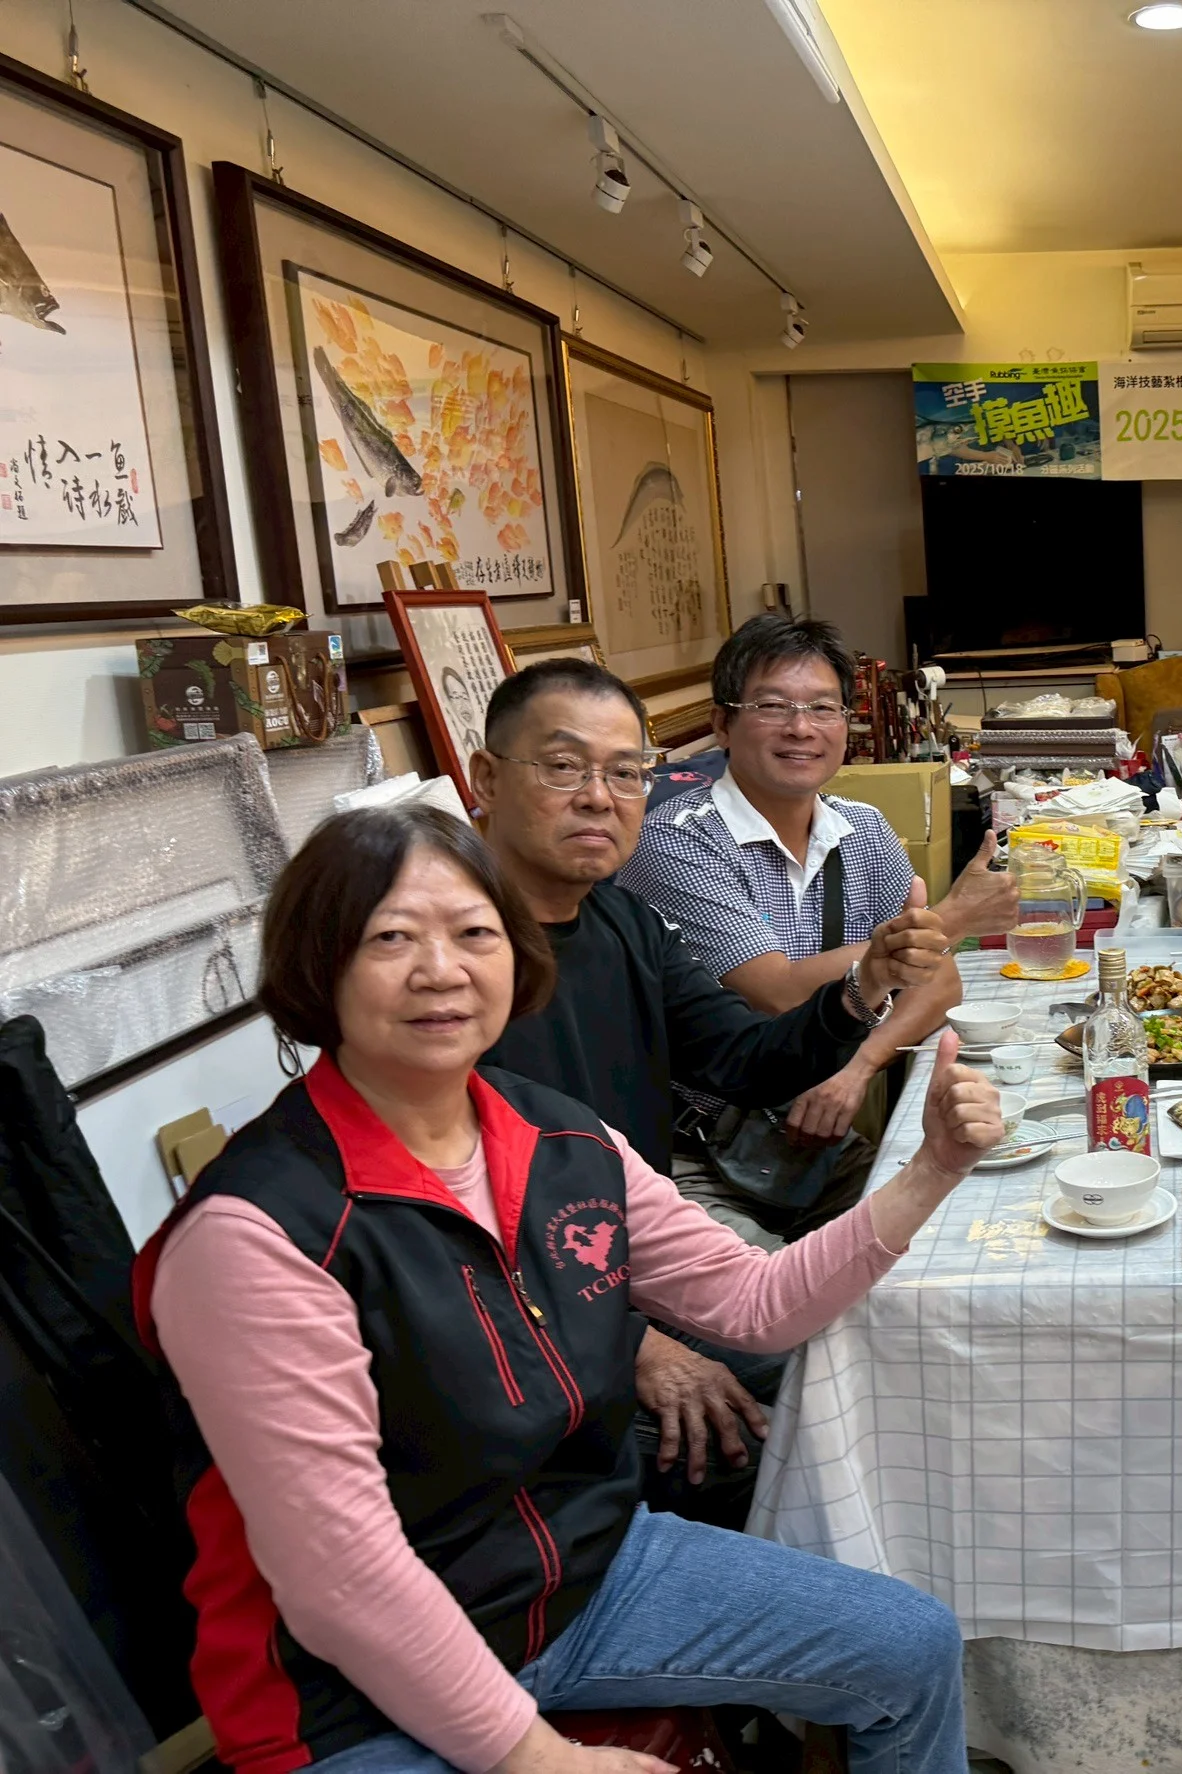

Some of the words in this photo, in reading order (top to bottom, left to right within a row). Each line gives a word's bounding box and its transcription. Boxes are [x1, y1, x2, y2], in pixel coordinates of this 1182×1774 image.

[942, 378, 987, 408] 空手
[970, 381, 1090, 446] 摸魚趣
[955, 463, 1024, 475] 2025/10/18
